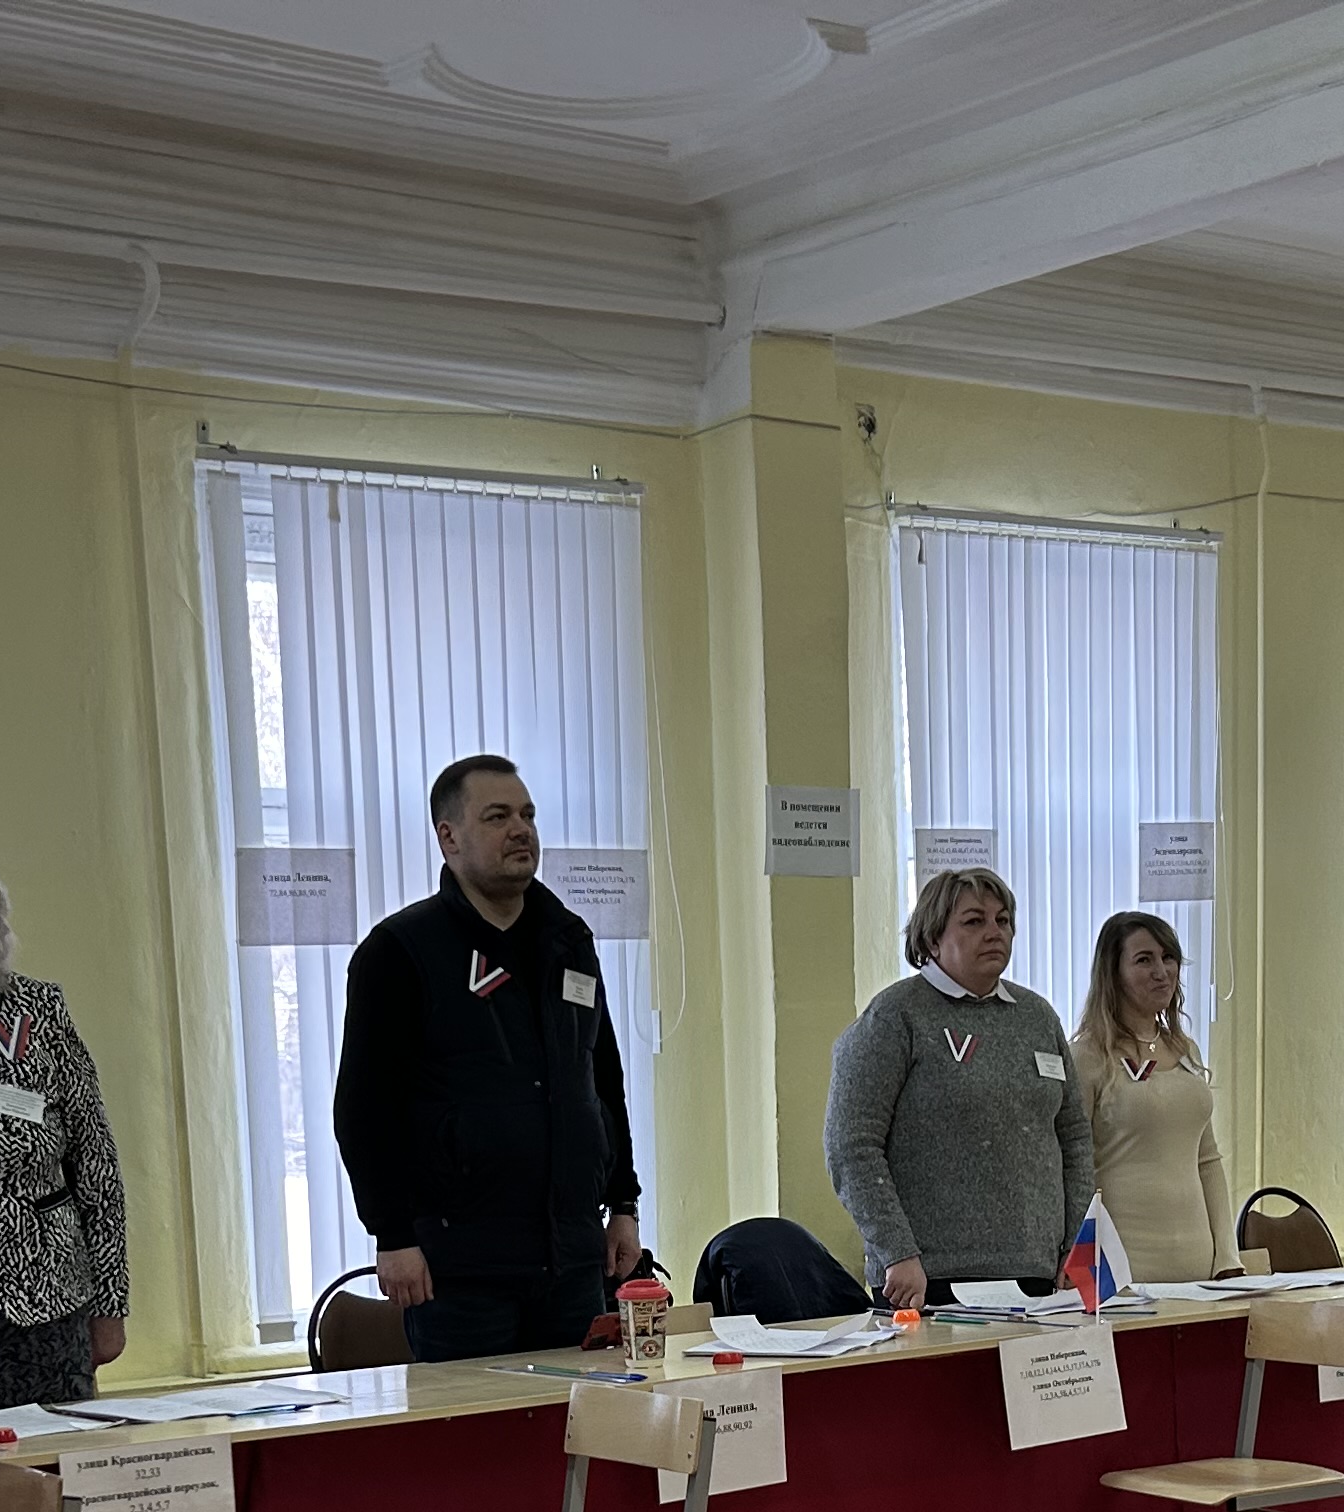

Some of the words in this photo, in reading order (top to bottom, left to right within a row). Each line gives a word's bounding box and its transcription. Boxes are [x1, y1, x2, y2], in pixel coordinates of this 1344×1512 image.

[781, 800, 788, 812] В
[789, 803, 841, 814] помещении
[772, 836, 851, 849] видеонаблюдение
[262, 874, 291, 884] улица
[293, 872, 331, 883] Ленина,
[716, 1402, 758, 1417] Ленина,
[715, 1420, 753, 1435] 6,88,90,92
[77, 1458, 109, 1473] улица
[111, 1445, 216, 1468] Красногвардейская,
[135, 1467, 161, 1480] 32,33
